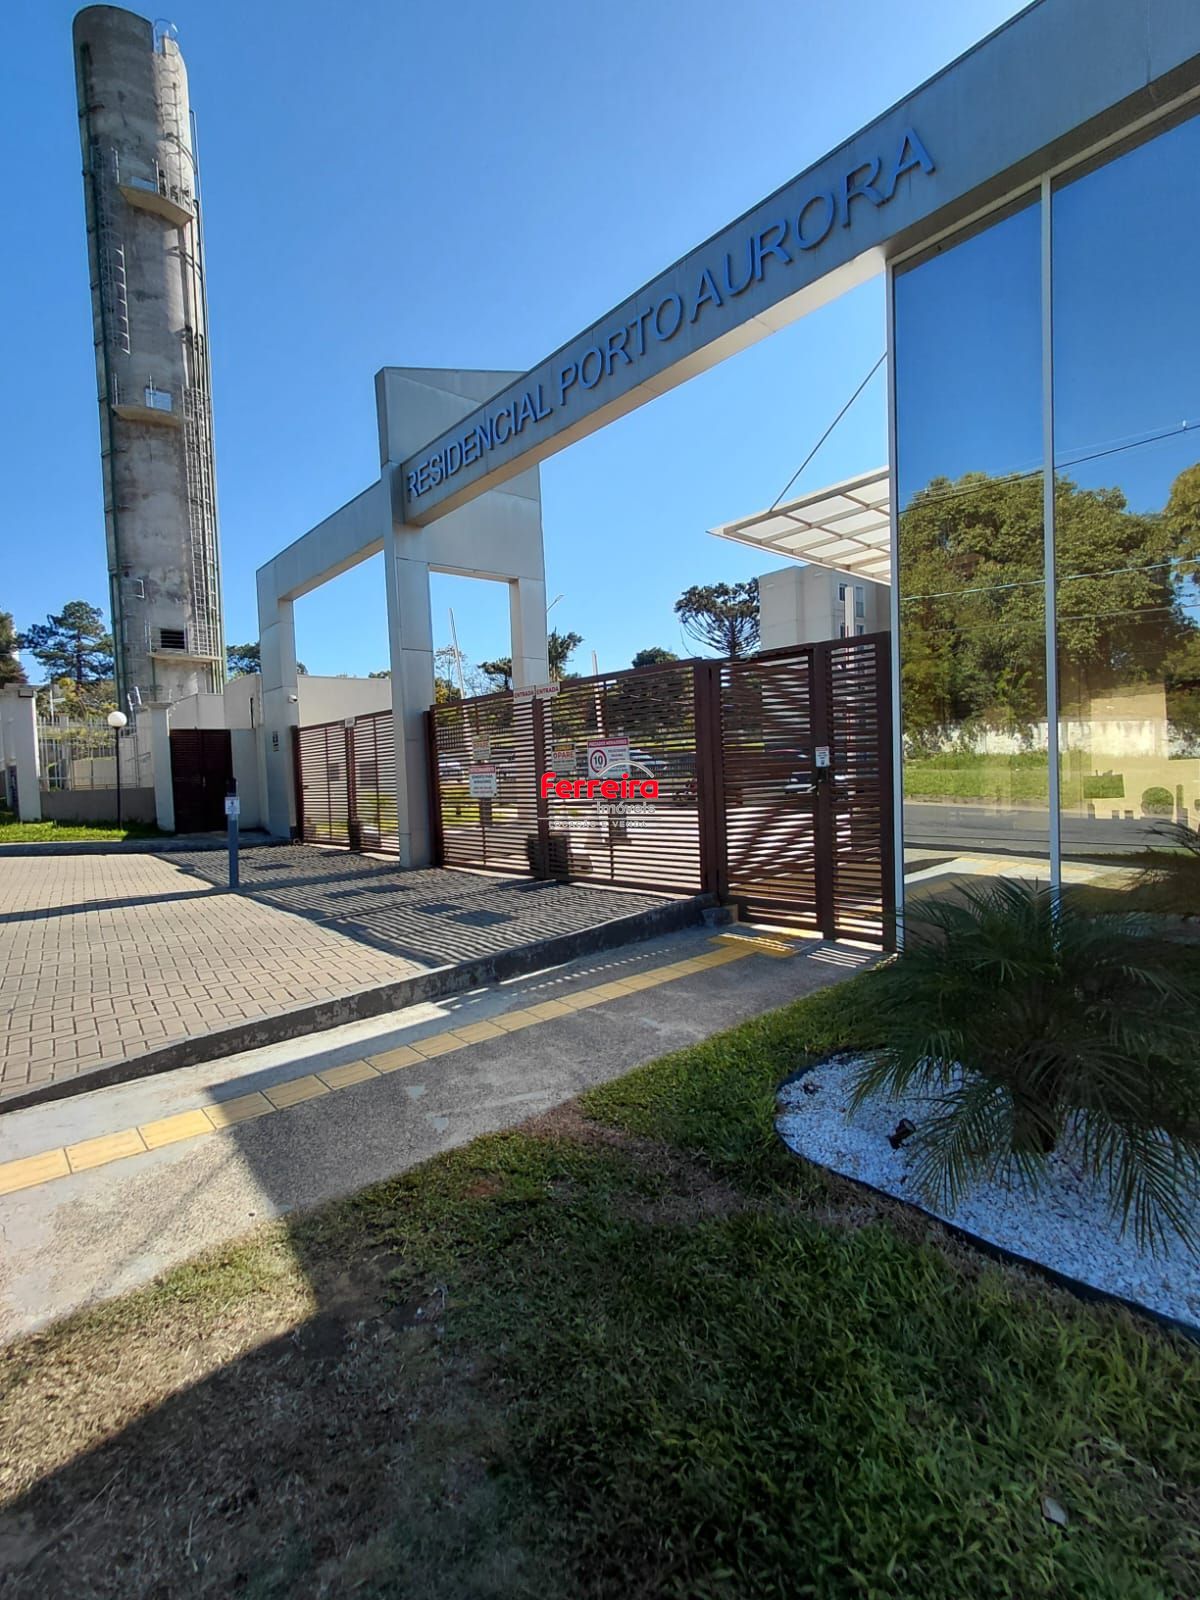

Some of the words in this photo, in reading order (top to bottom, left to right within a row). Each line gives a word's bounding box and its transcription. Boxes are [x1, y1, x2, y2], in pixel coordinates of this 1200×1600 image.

[406, 384, 553, 497] RESIDENCIAL
[557, 290, 683, 408] PORTO
[690, 127, 935, 324] AURORA
[536, 686, 559, 695] ENTRADA
[593, 755, 603, 765] 10
